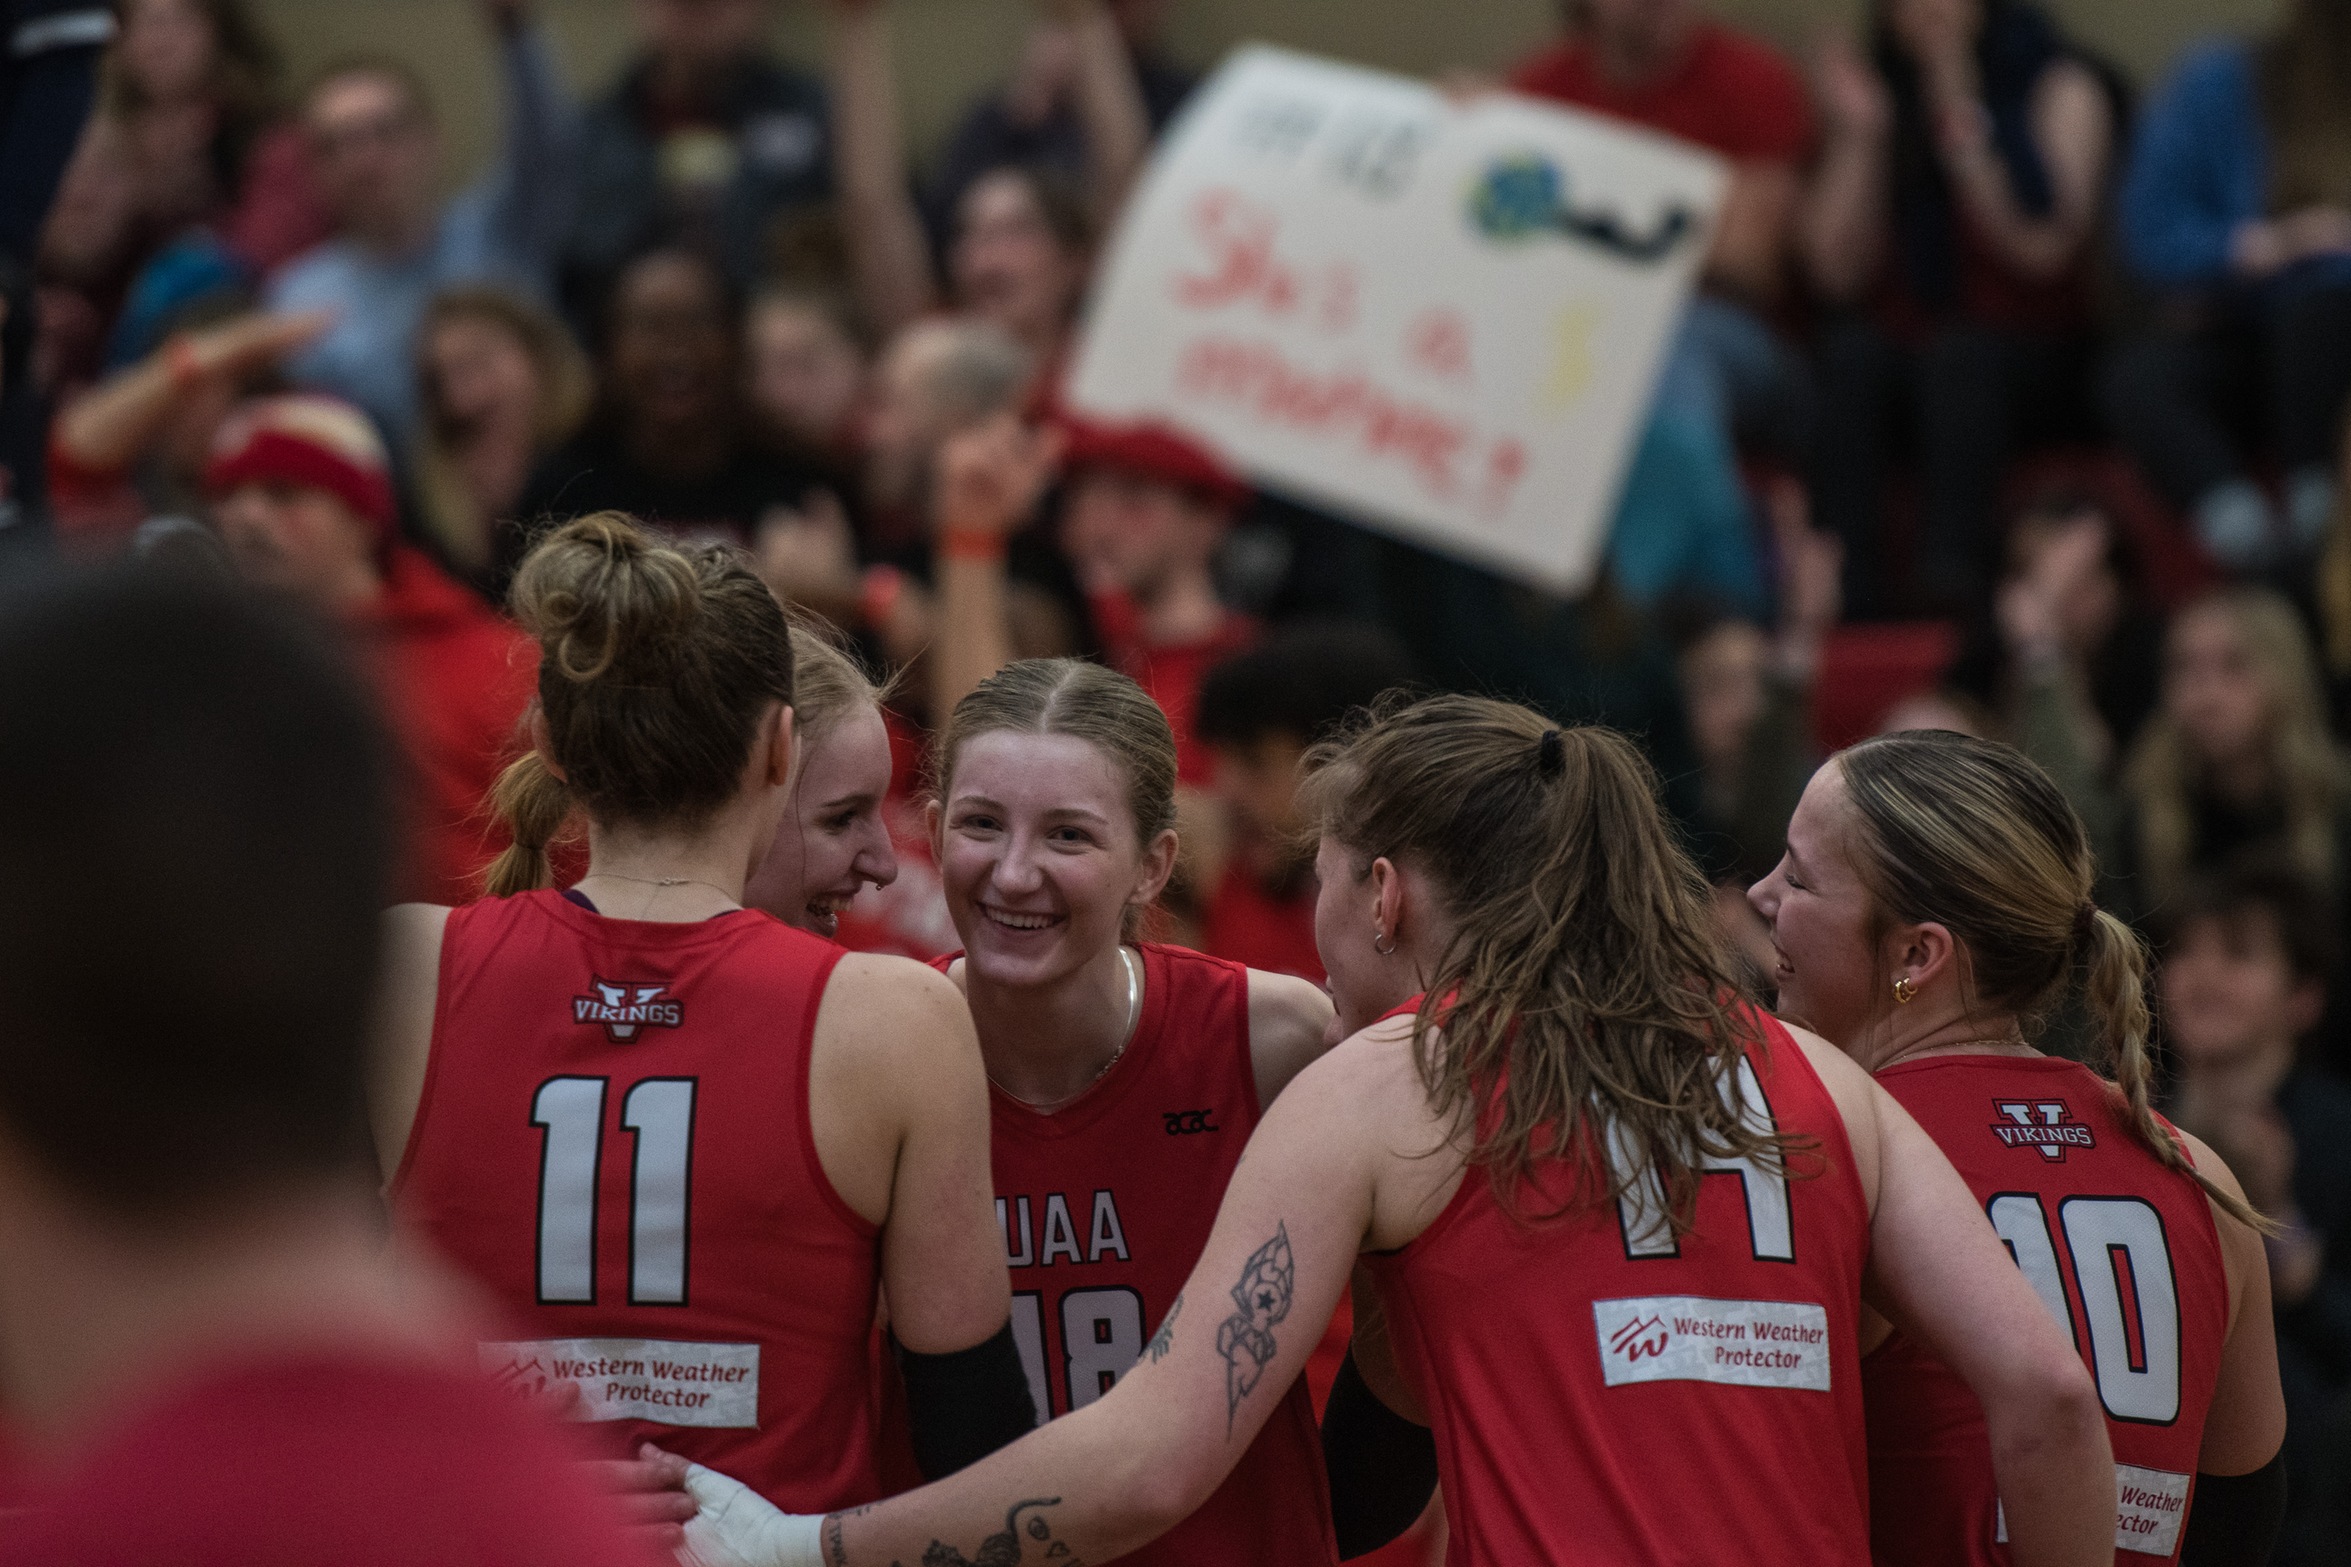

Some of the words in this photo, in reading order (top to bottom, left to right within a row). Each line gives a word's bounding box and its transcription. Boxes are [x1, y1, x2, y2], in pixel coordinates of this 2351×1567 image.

[575, 999, 679, 1025] VIKINGS
[1996, 1127, 2091, 1145] VIKINGS
[529, 1074, 698, 1307] 11
[994, 1188, 1132, 1267] UAA
[1674, 1317, 1746, 1340] Western
[1753, 1321, 1824, 1345] Weather
[552, 1356, 645, 1379] Western
[651, 1358, 750, 1383] Weather
[1714, 1346, 1802, 1369] Protector
[605, 1381, 711, 1408] Protector
[2121, 1486, 2184, 1512] Weather
[2115, 1514, 2160, 1535] ector
